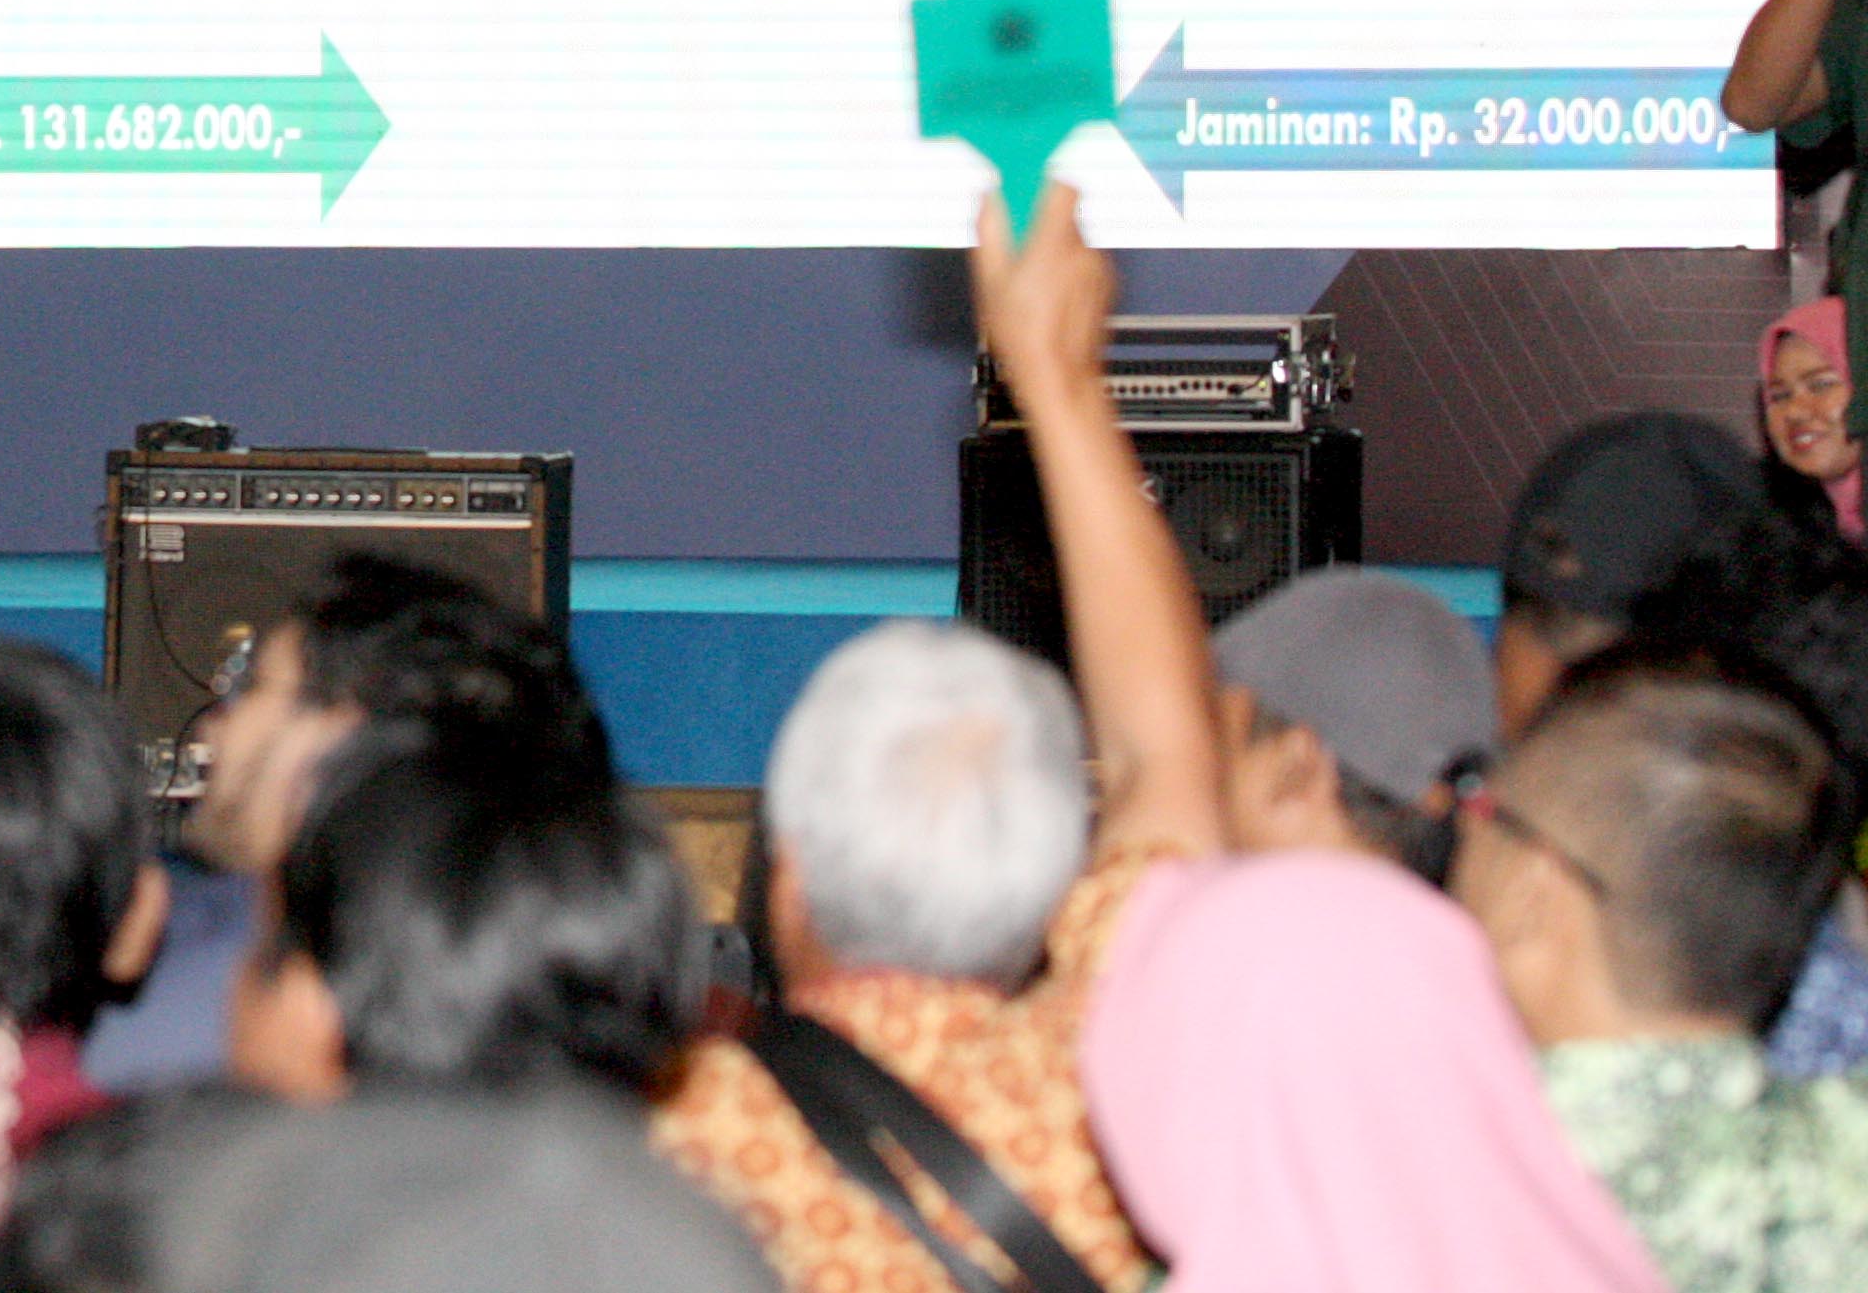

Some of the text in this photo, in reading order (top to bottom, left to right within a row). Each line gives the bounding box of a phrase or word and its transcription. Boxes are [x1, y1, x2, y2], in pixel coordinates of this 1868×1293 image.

[20, 104, 301, 157] 131.682.000,-
[1177, 99, 1370, 146] Jaminan:
[1390, 99, 1455, 156] Rp.
